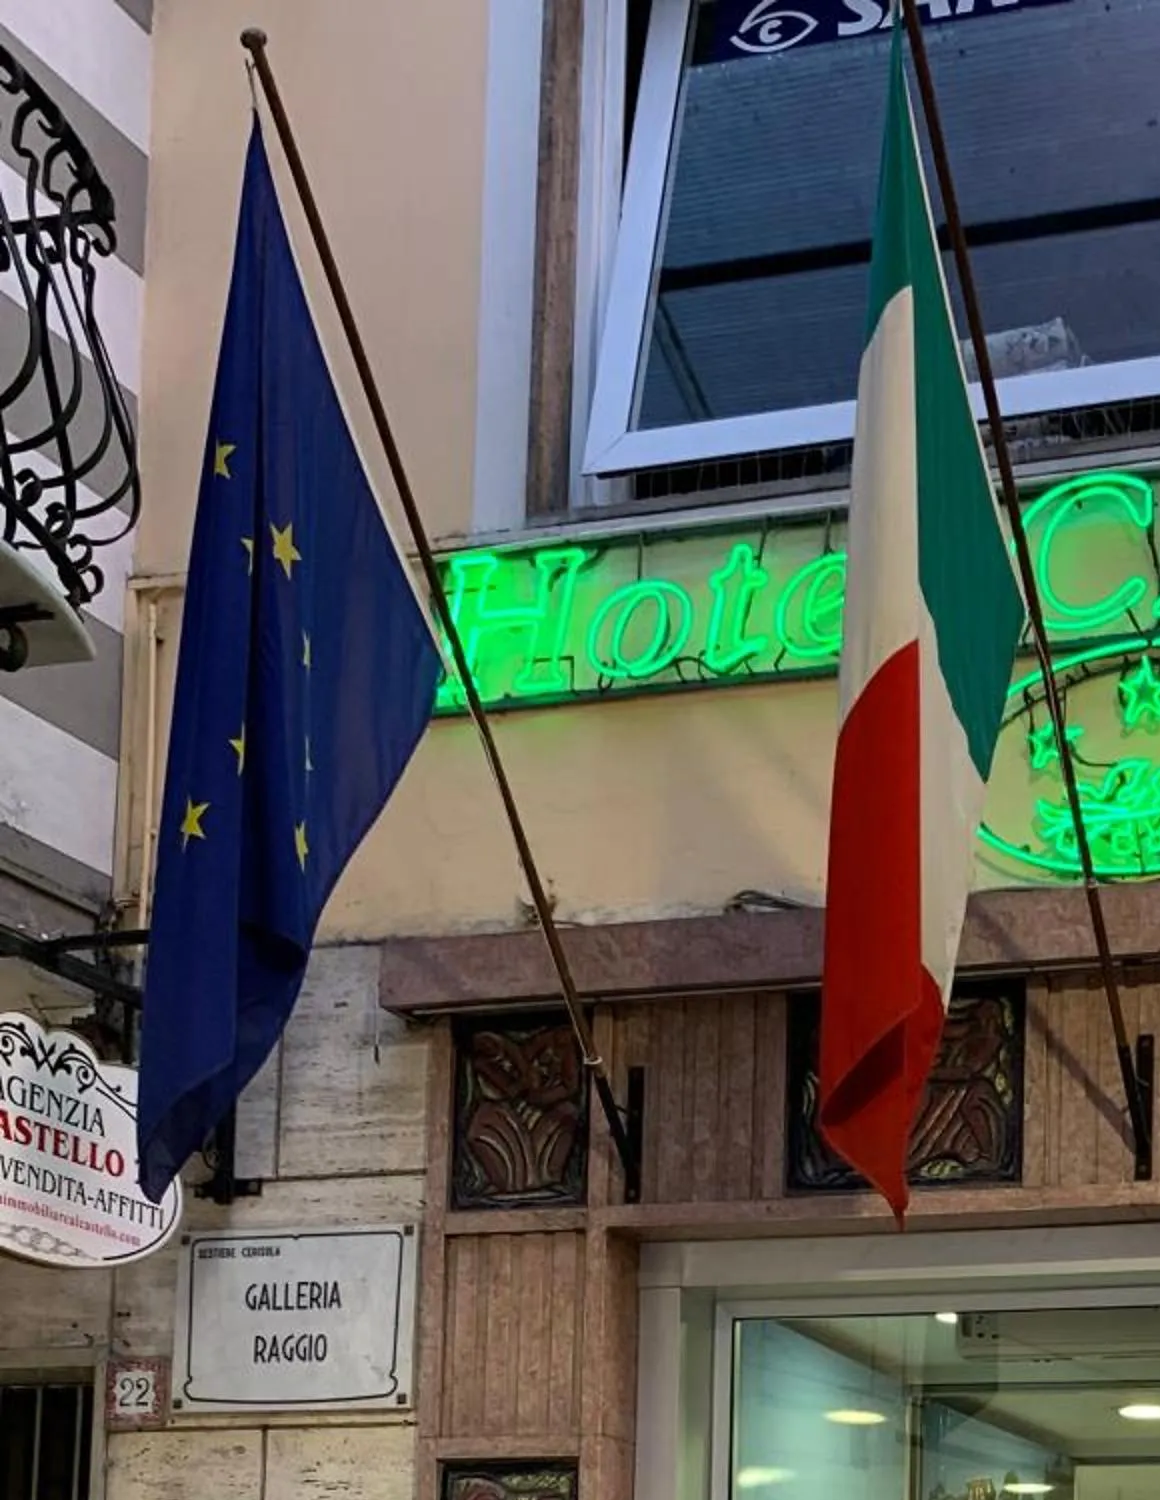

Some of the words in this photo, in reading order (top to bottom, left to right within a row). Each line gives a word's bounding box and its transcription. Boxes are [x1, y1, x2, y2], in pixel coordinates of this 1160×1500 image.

[437, 542, 847, 705] Hote
[0, 1109, 125, 1177] ASTELLO
[0, 1154, 164, 1230] VENDITA-AFFITTI
[245, 1281, 342, 1311] GALLERIA
[253, 1334, 328, 1364] RAGGIO
[119, 1377, 150, 1407] 22
